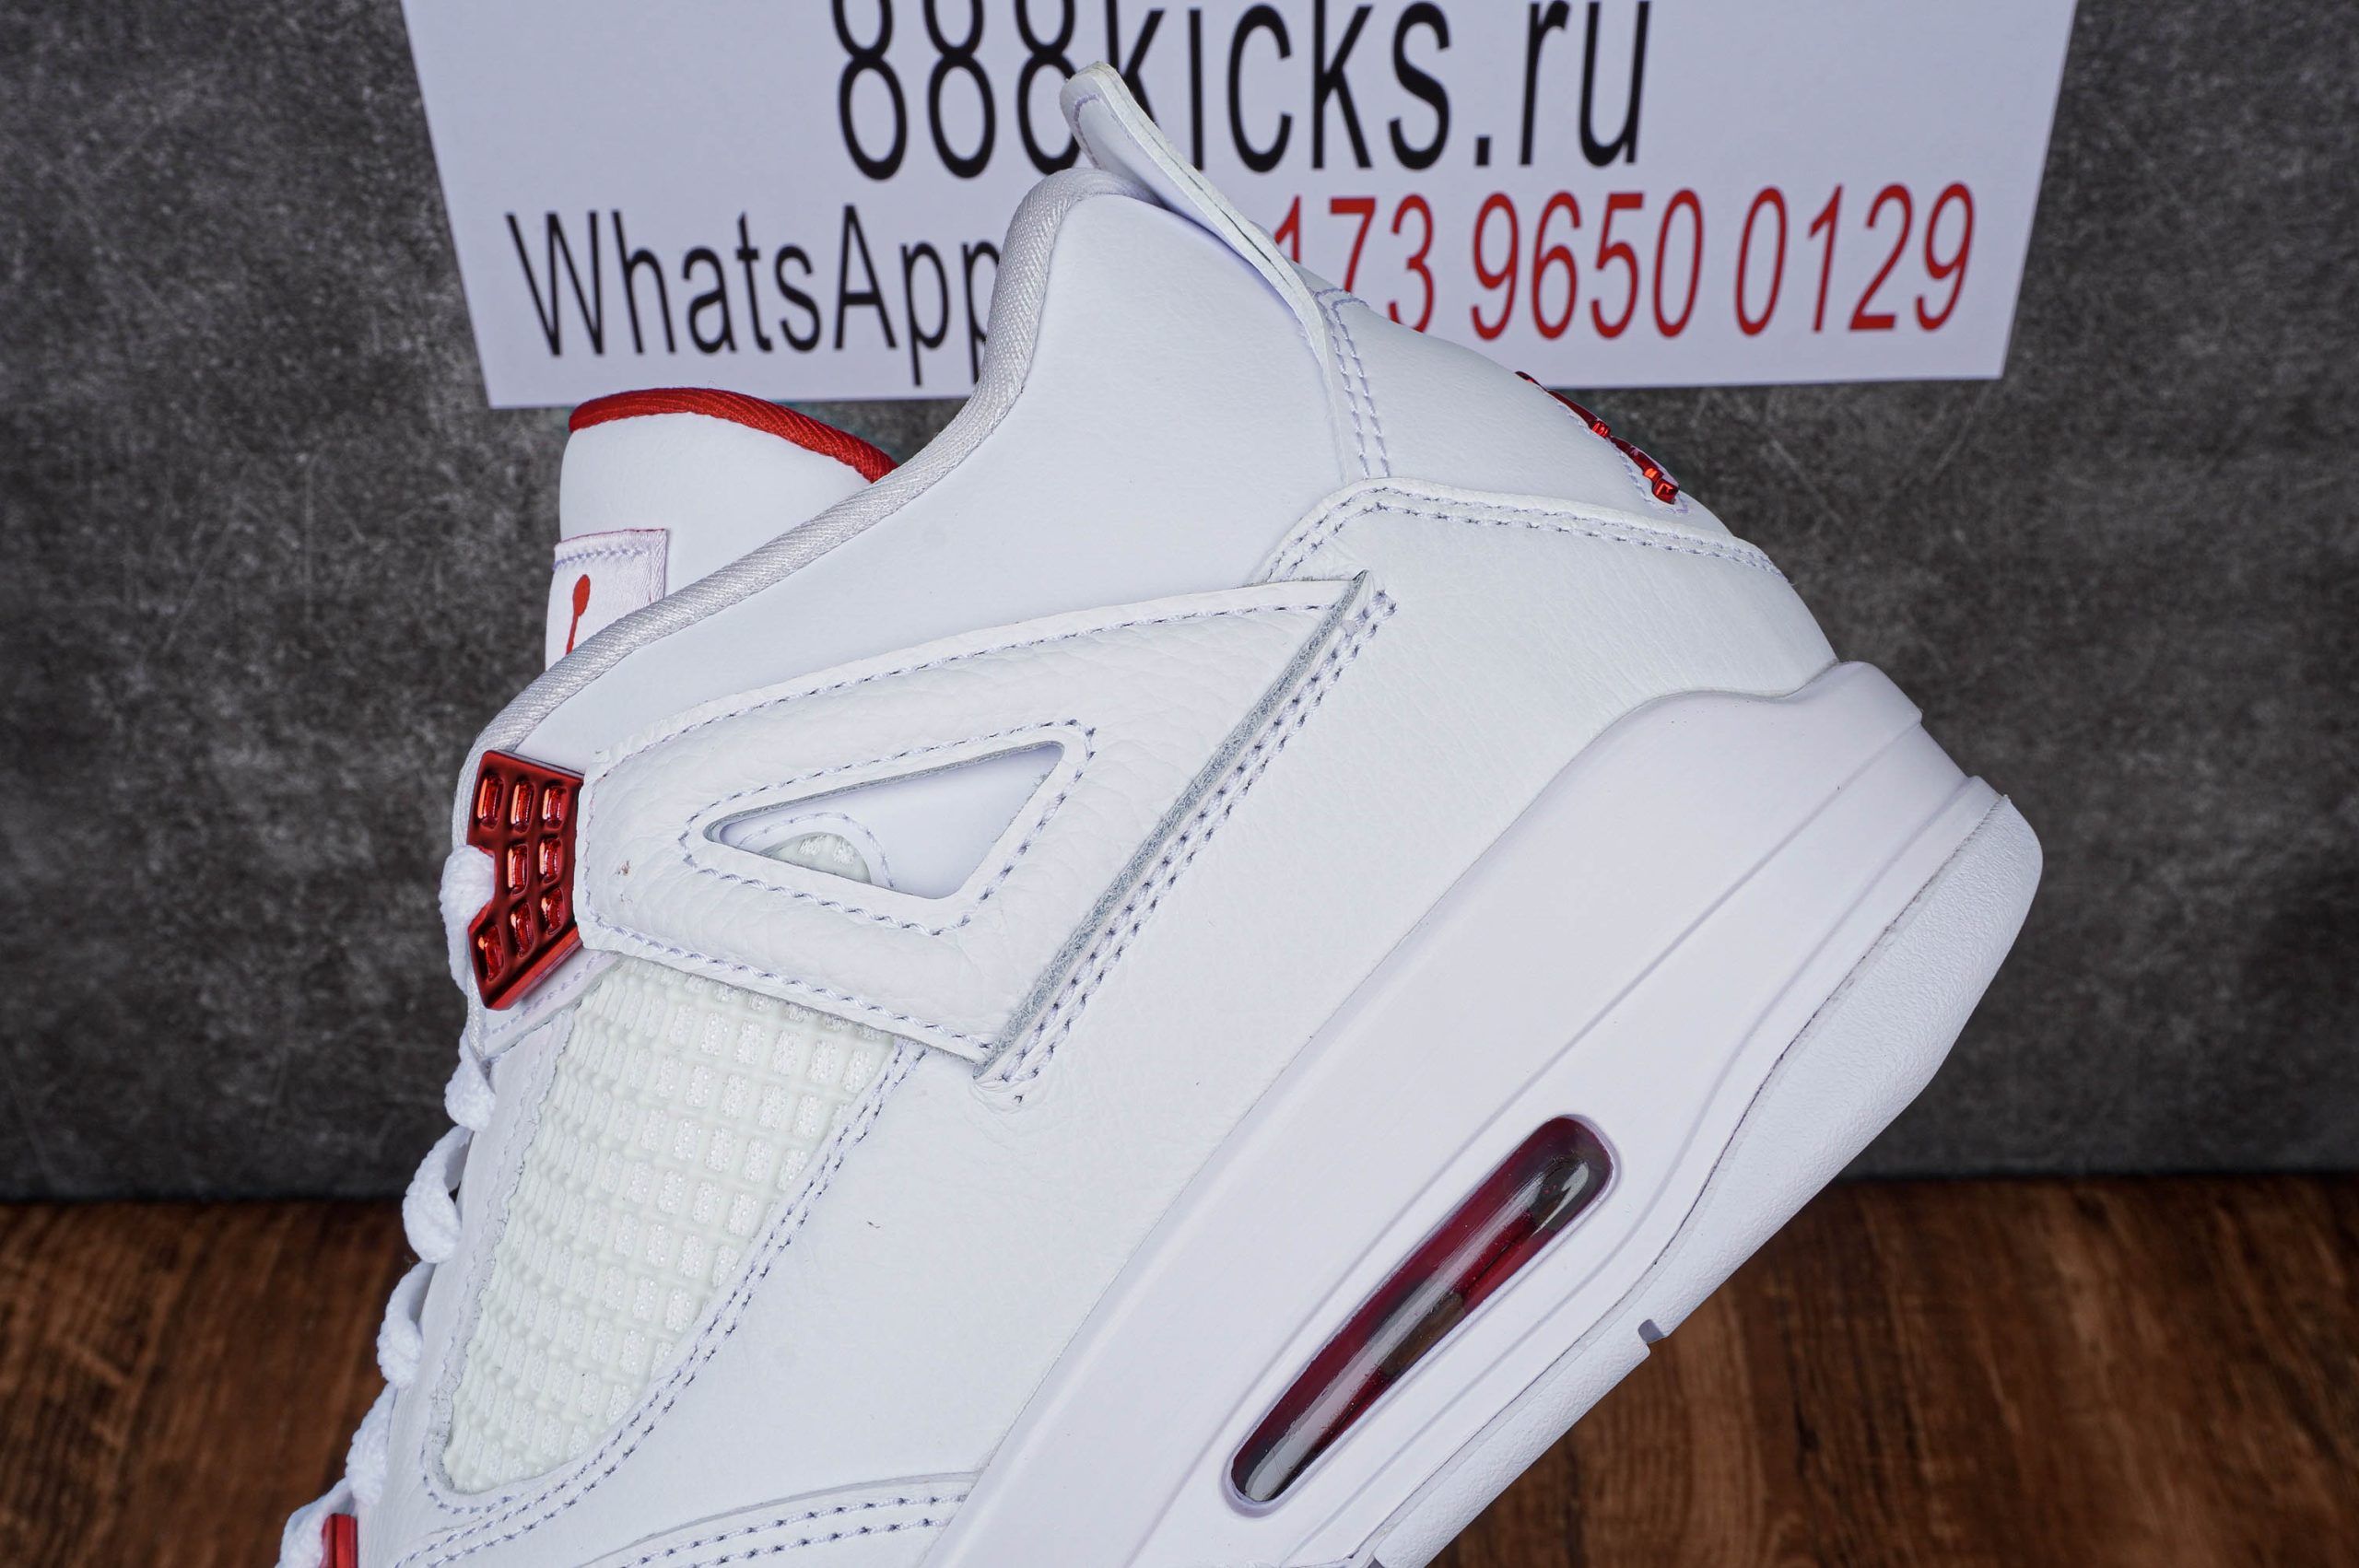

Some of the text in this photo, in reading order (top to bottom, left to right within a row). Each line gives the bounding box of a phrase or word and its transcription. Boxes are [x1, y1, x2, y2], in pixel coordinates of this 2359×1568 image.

[833, 0, 1649, 180] 888kicks.ru
[505, 205, 1000, 385] WhatsApp
[1470, 188, 1703, 341] 9650
[1735, 182, 1975, 337] 0129
